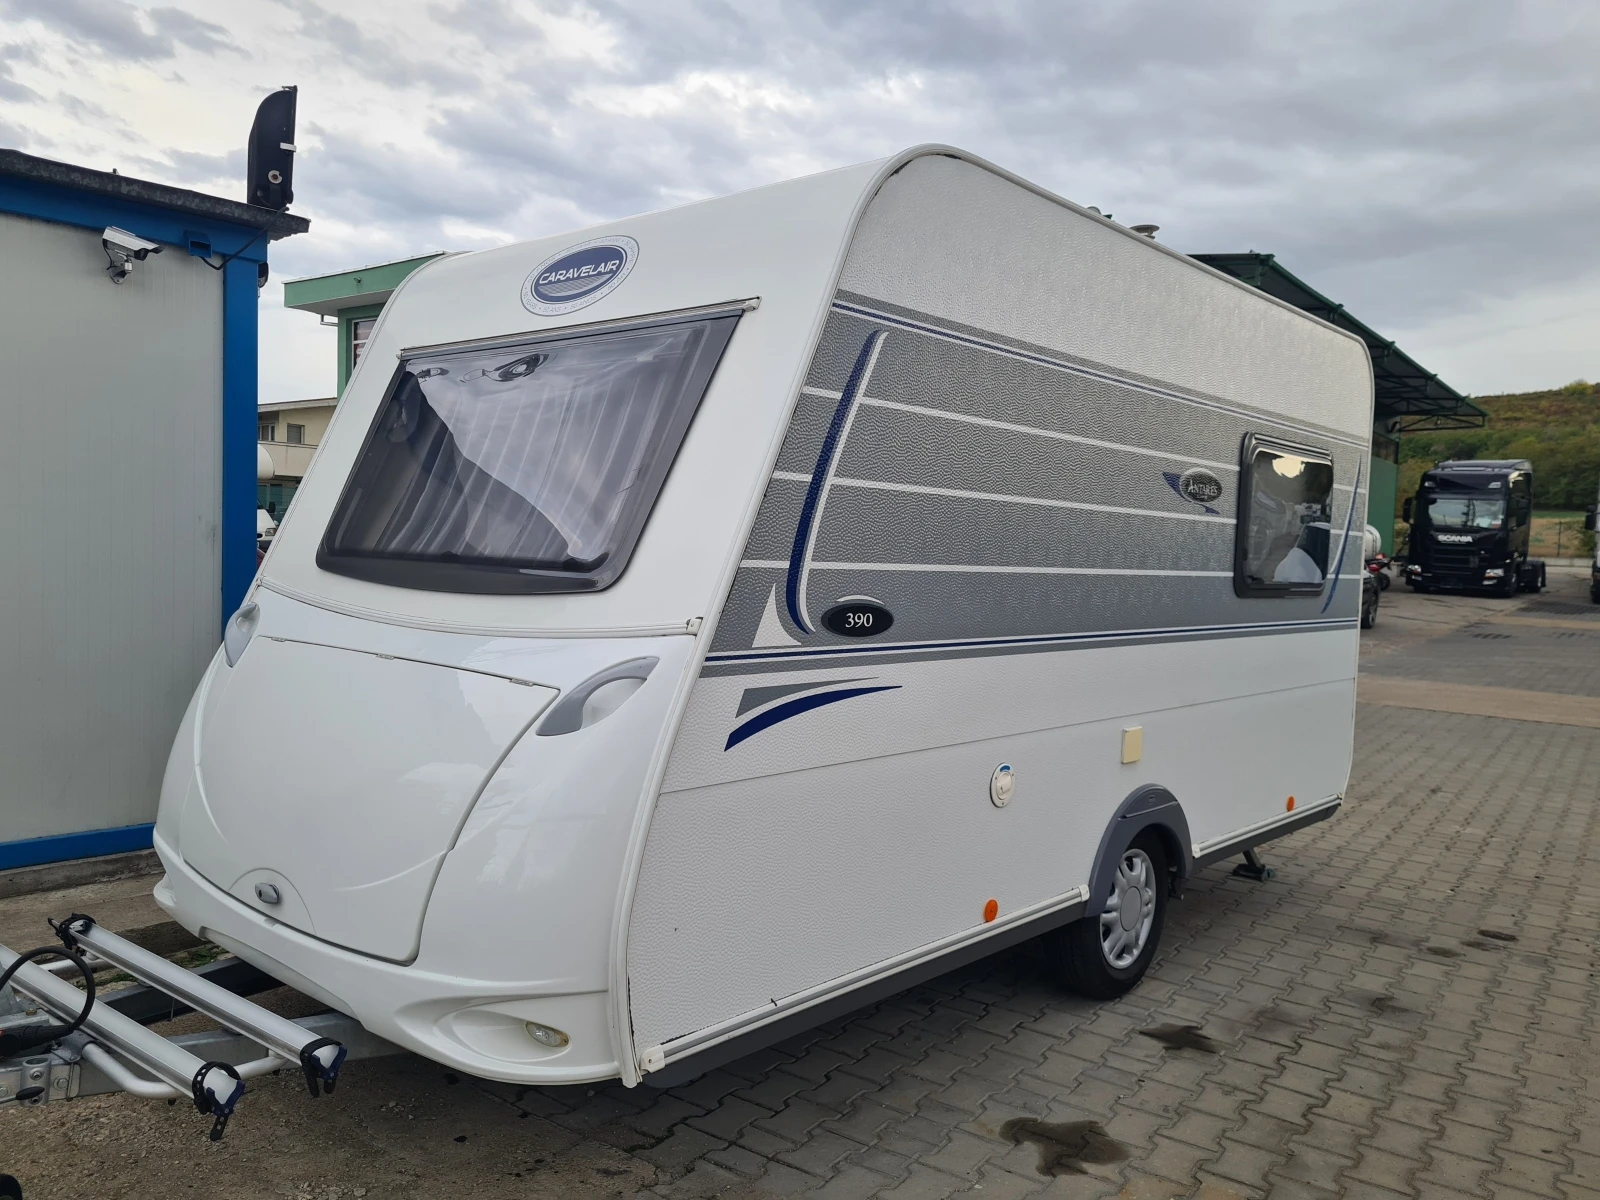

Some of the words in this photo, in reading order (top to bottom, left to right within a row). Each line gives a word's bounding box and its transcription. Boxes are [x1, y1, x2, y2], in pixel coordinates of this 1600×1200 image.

[539, 260, 620, 284] CARAVELAIR
[1437, 534, 1473, 543] SCANIA
[845, 613, 873, 628] 390
